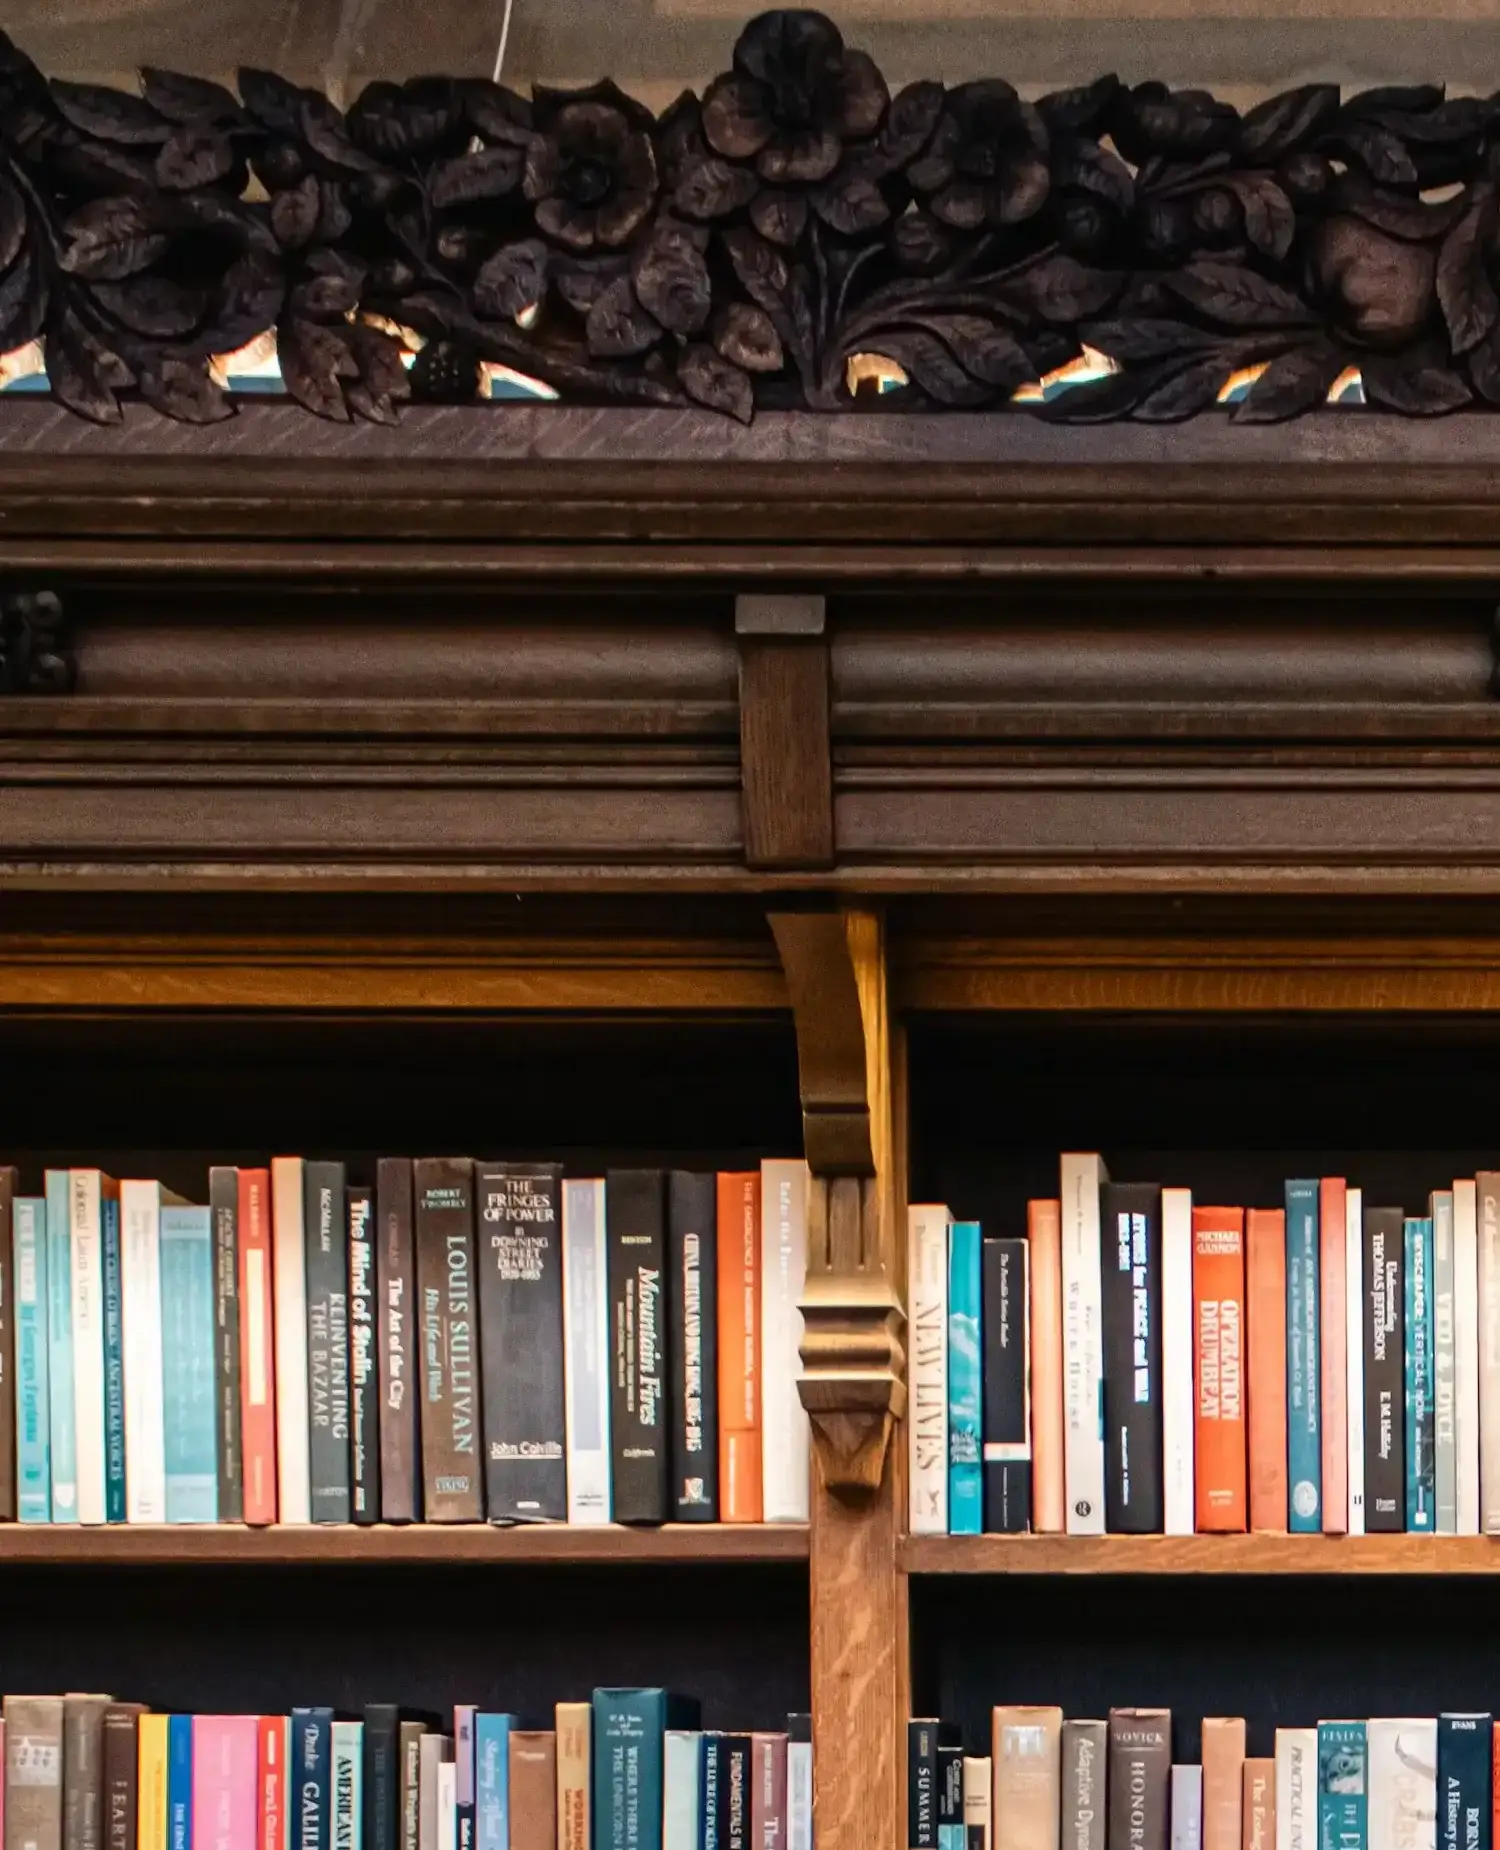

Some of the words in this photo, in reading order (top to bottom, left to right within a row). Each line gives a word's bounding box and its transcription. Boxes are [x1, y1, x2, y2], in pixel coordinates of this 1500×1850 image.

[351, 1200, 368, 1237] The
[353, 1242, 369, 1294] Mind
[446, 1236, 467, 1313] LOUIS
[1373, 1233, 1384, 1290] THOMAS
[354, 1299, 370, 1322] of
[388, 1278, 402, 1306] The
[389, 1308, 402, 1332] Art
[638, 1267, 661, 1372] Mountain
[311, 1302, 327, 1344] THE
[389, 1336, 402, 1351] of
[916, 1302, 942, 1373] NEW
[1371, 1292, 1385, 1360] JEFFERSON
[329, 1293, 348, 1439] REINVENTING
[354, 1326, 371, 1385] Stalin
[390, 1356, 403, 1376] the
[1200, 1301, 1218, 1419] DRUMBEAT
[1221, 1300, 1239, 1420] OPERATION
[312, 1350, 328, 1425] BAZAAR
[388, 1380, 403, 1409] City
[450, 1321, 473, 1453] SULLIVAN
[639, 1377, 662, 1425] Fires
[916, 1383, 943, 1471] LIVES
[336, 1755, 352, 1842] AMERICAN
[729, 1752, 742, 1834] FUNDAMENTALS
[1072, 1738, 1094, 1805] Adaptive
[1448, 1777, 1459, 1790] A
[729, 1837, 741, 1848] IN
[1445, 1793, 1460, 1840] History
[1465, 1808, 1479, 1850] BORN
